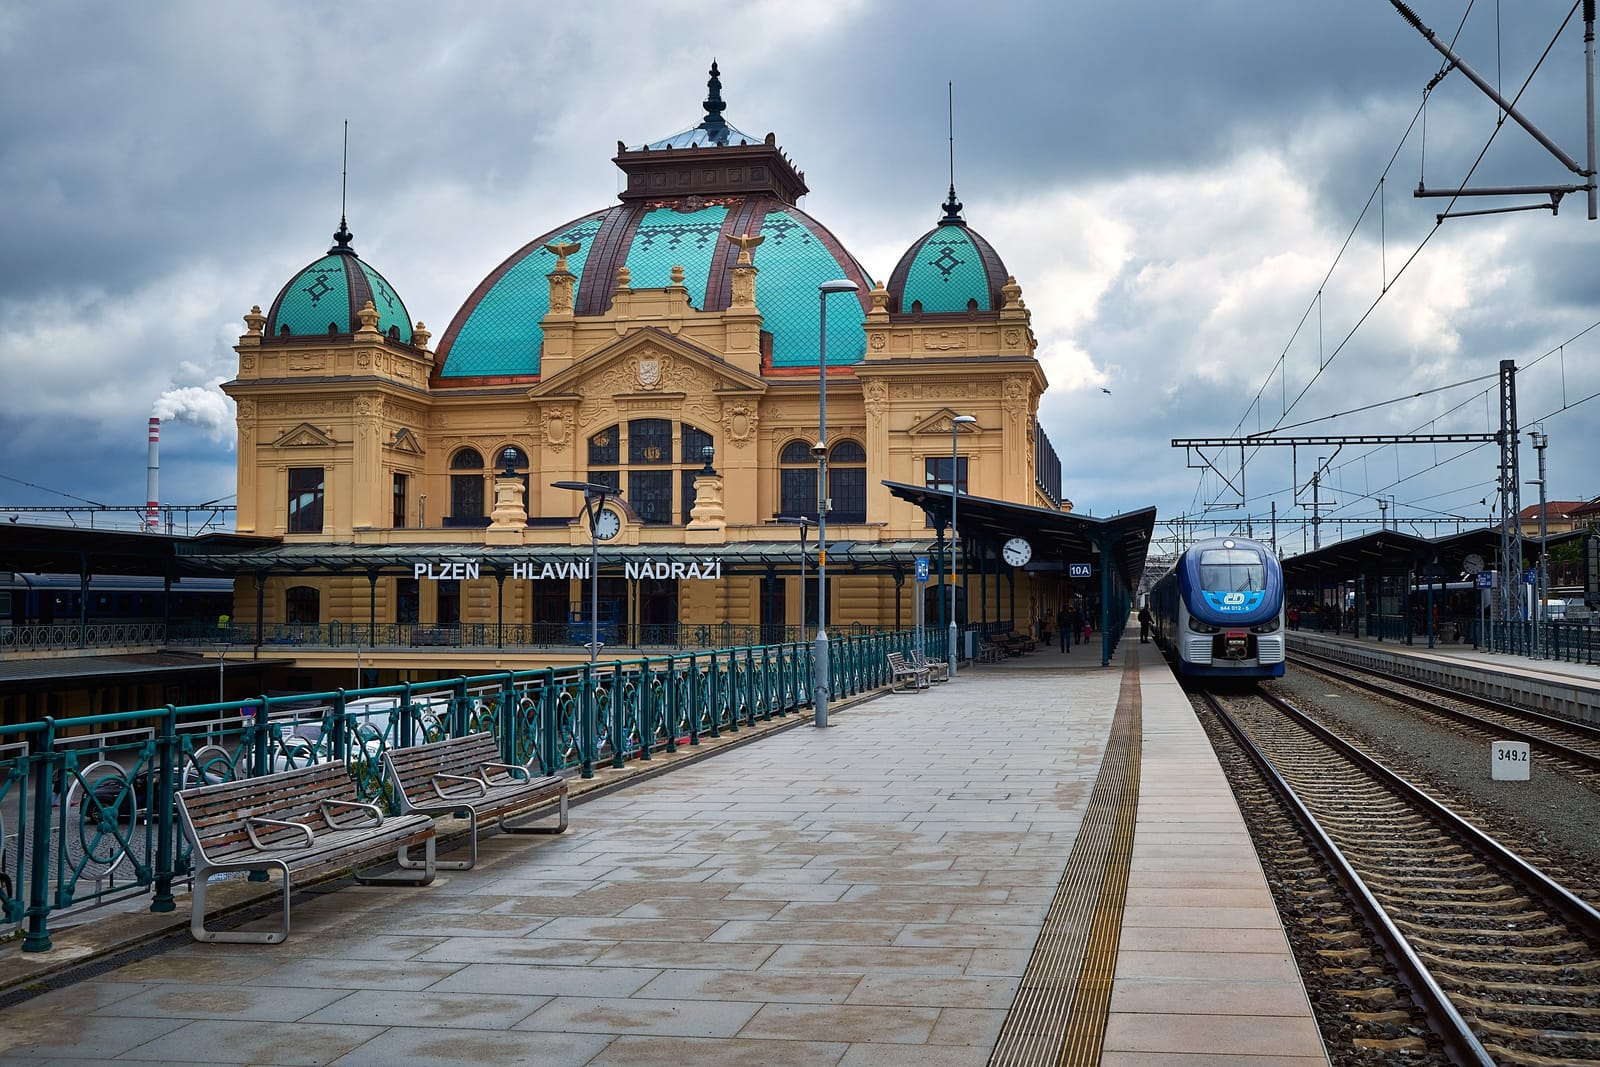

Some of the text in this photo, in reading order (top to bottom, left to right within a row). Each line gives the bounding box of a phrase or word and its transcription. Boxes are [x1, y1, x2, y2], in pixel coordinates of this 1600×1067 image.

[414, 558, 722, 580] PLZEŇ HLAVNÍ NÁDRAŽÍ
[1498, 749, 1527, 762] 349.2
